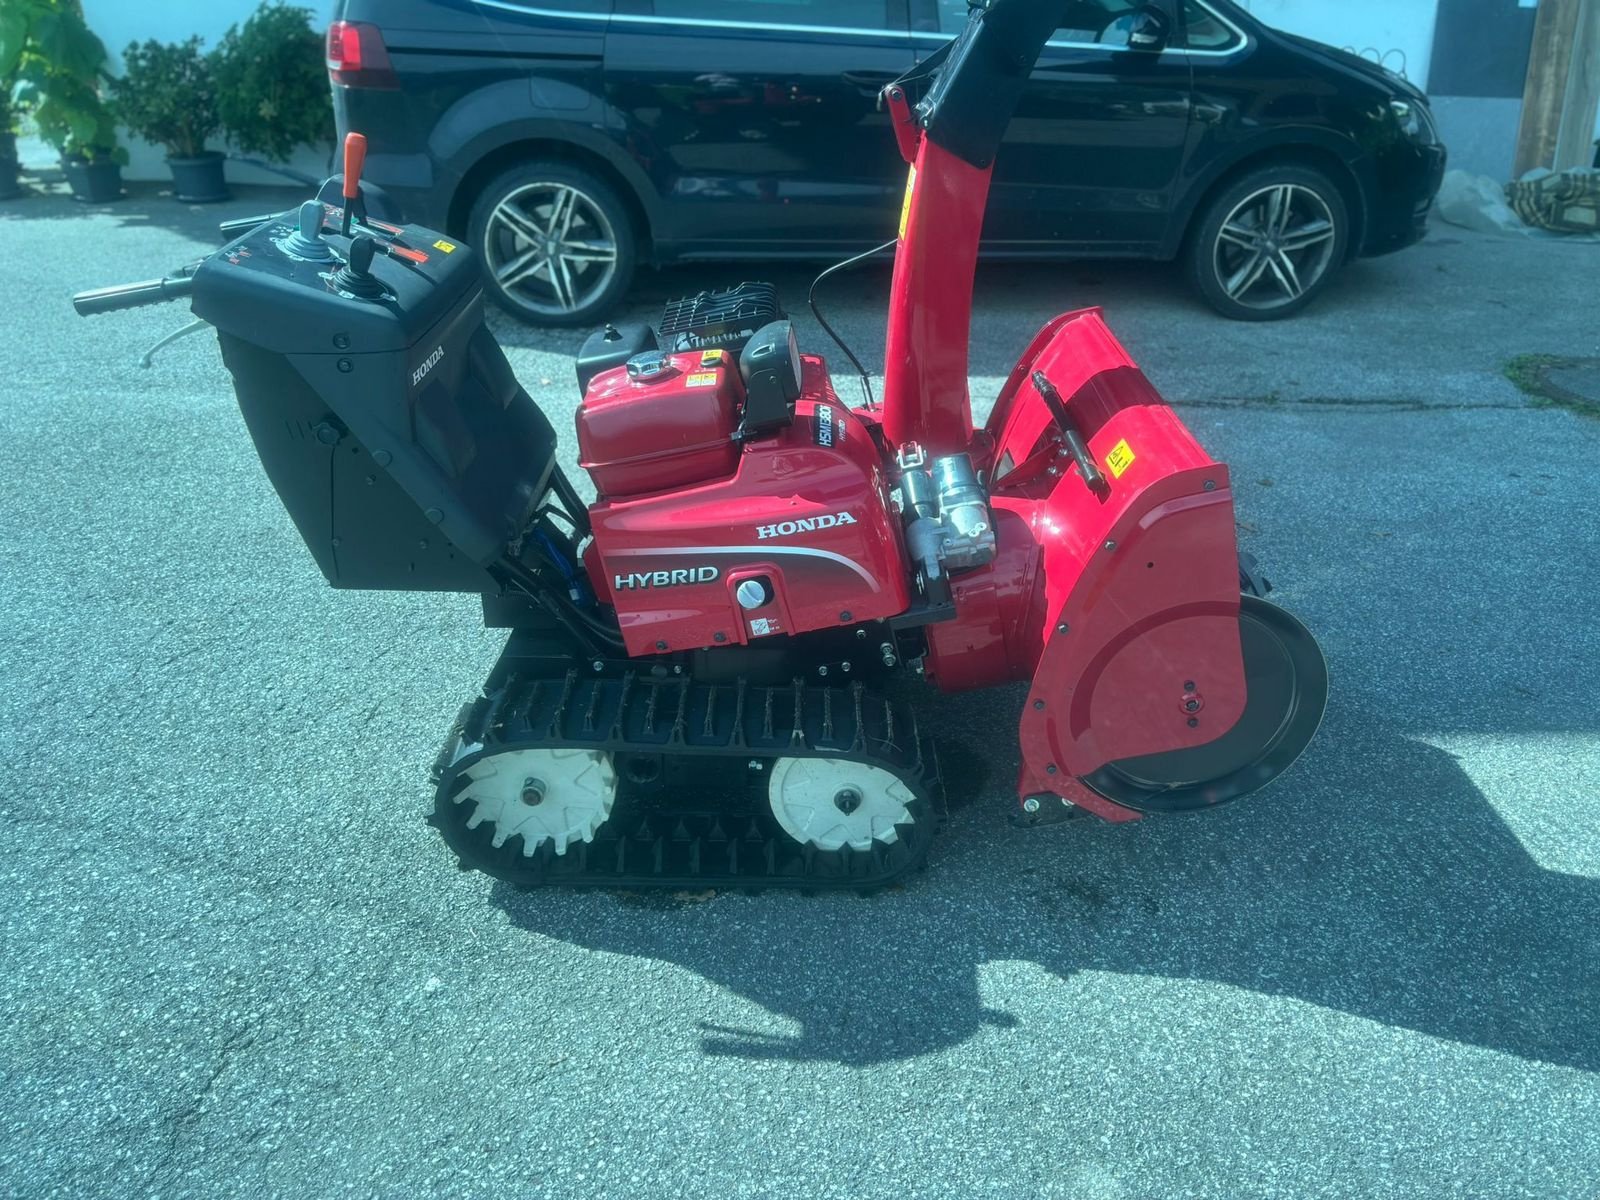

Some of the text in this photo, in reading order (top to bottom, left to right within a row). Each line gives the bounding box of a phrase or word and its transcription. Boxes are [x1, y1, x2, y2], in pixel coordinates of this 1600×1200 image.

[412, 345, 444, 386] HONDA
[756, 511, 857, 539] HONDA
[615, 566, 718, 589] HYBRID
